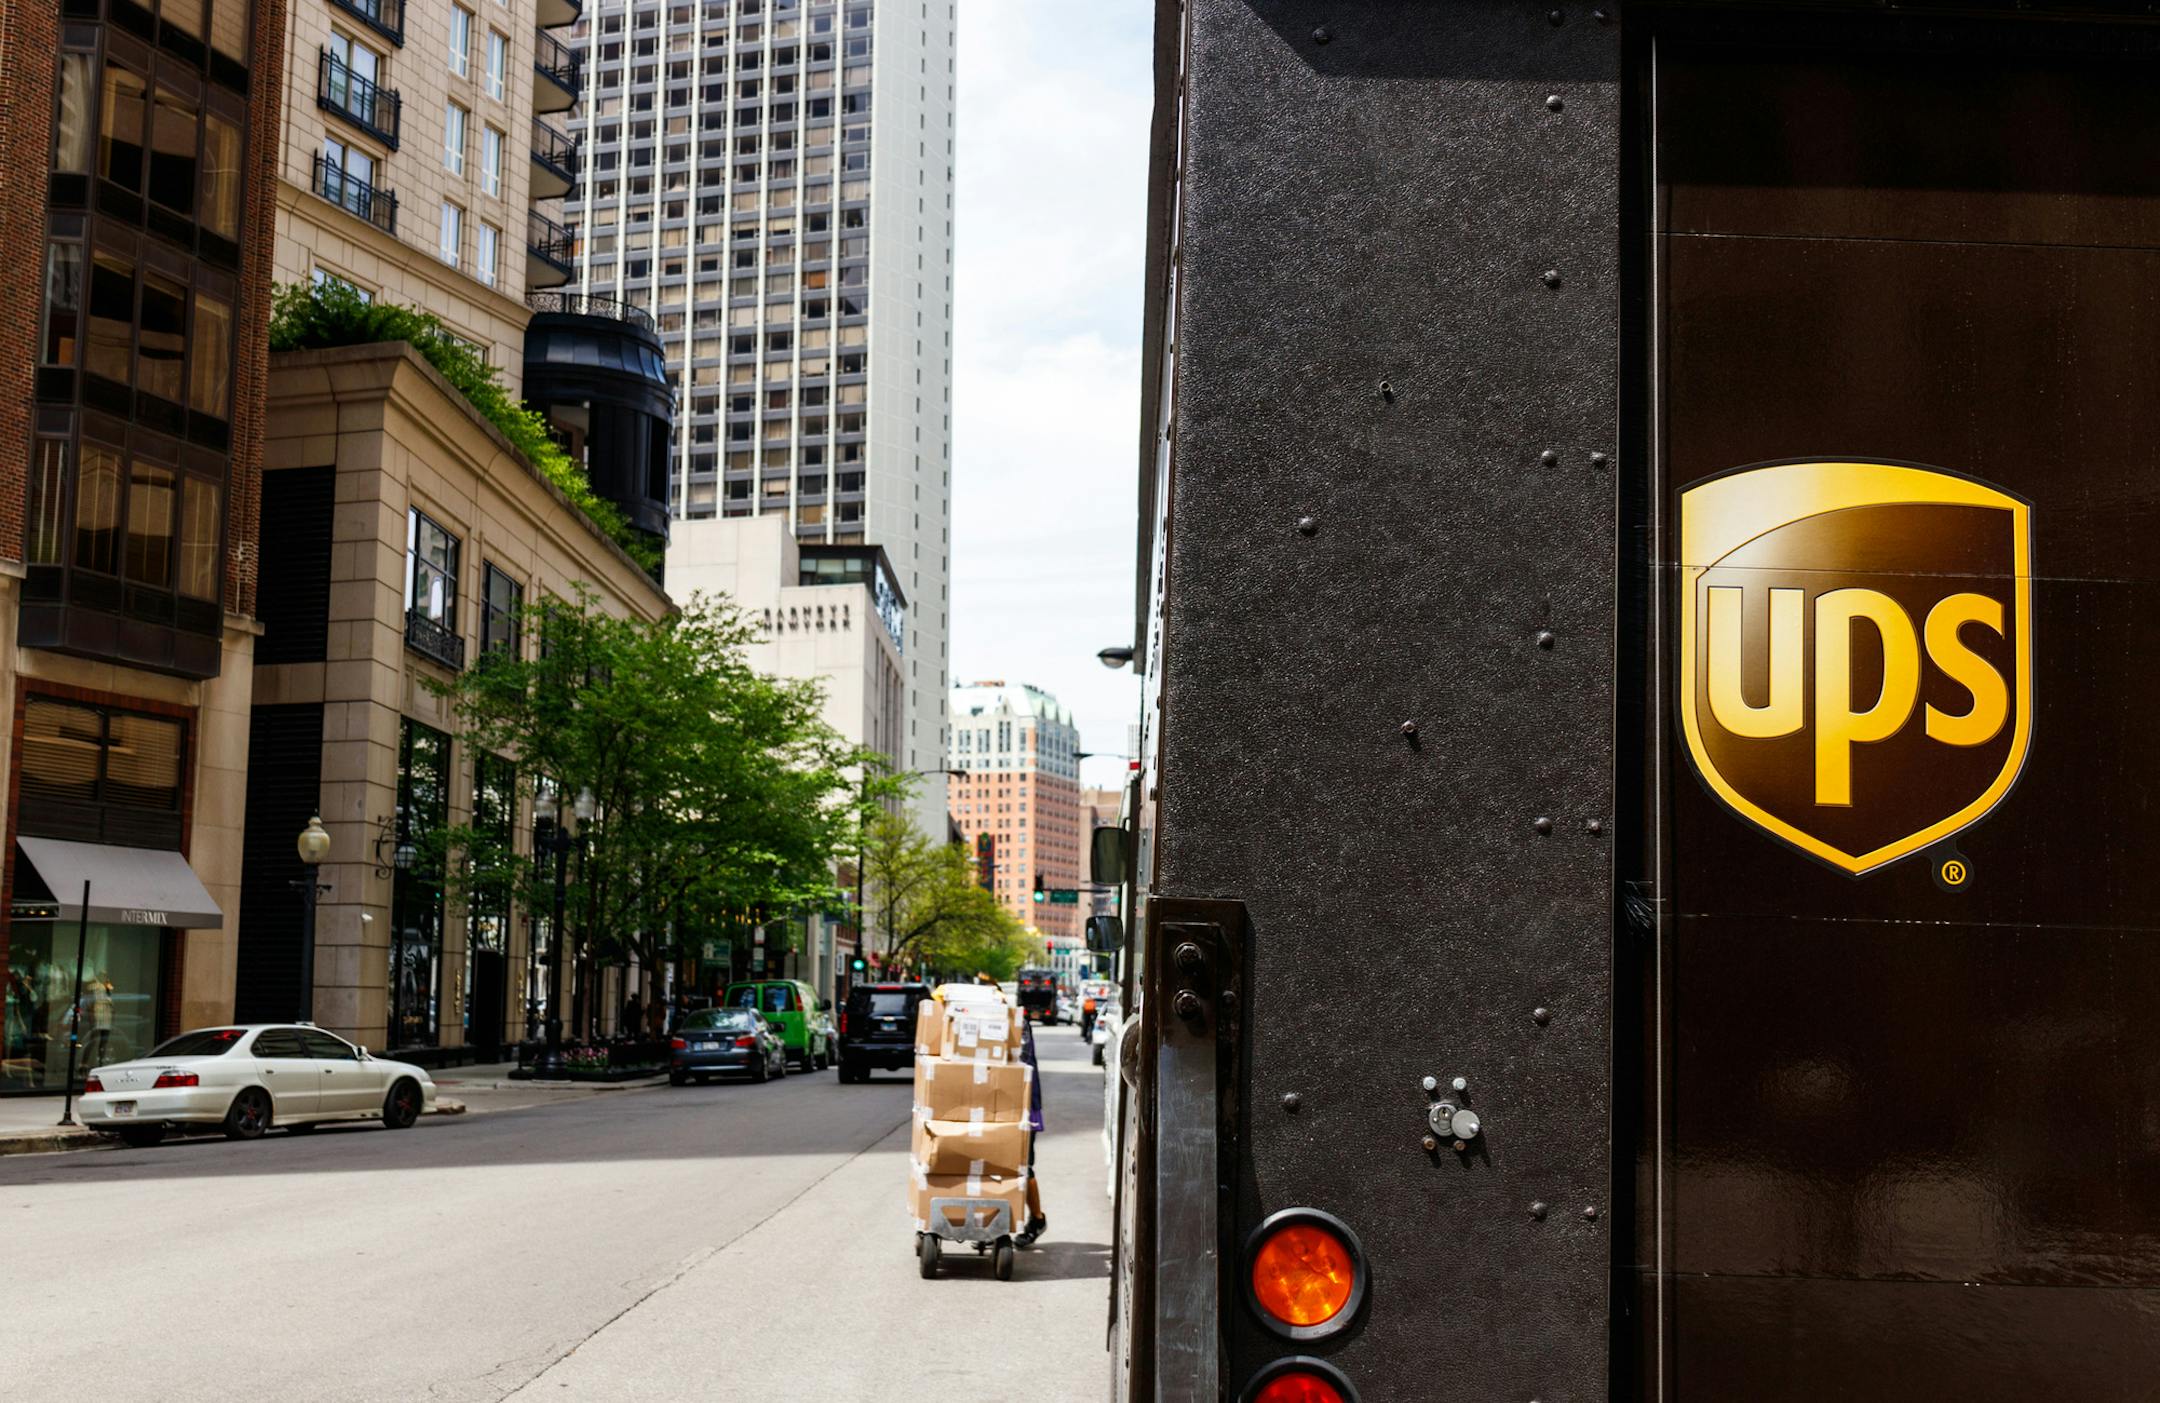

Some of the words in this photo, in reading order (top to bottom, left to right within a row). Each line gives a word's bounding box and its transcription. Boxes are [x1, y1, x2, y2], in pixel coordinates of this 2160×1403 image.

[764, 604, 849, 620] BARNEYS
[1707, 586, 2010, 807] ups
[120, 908, 168, 925] INTERMIX
